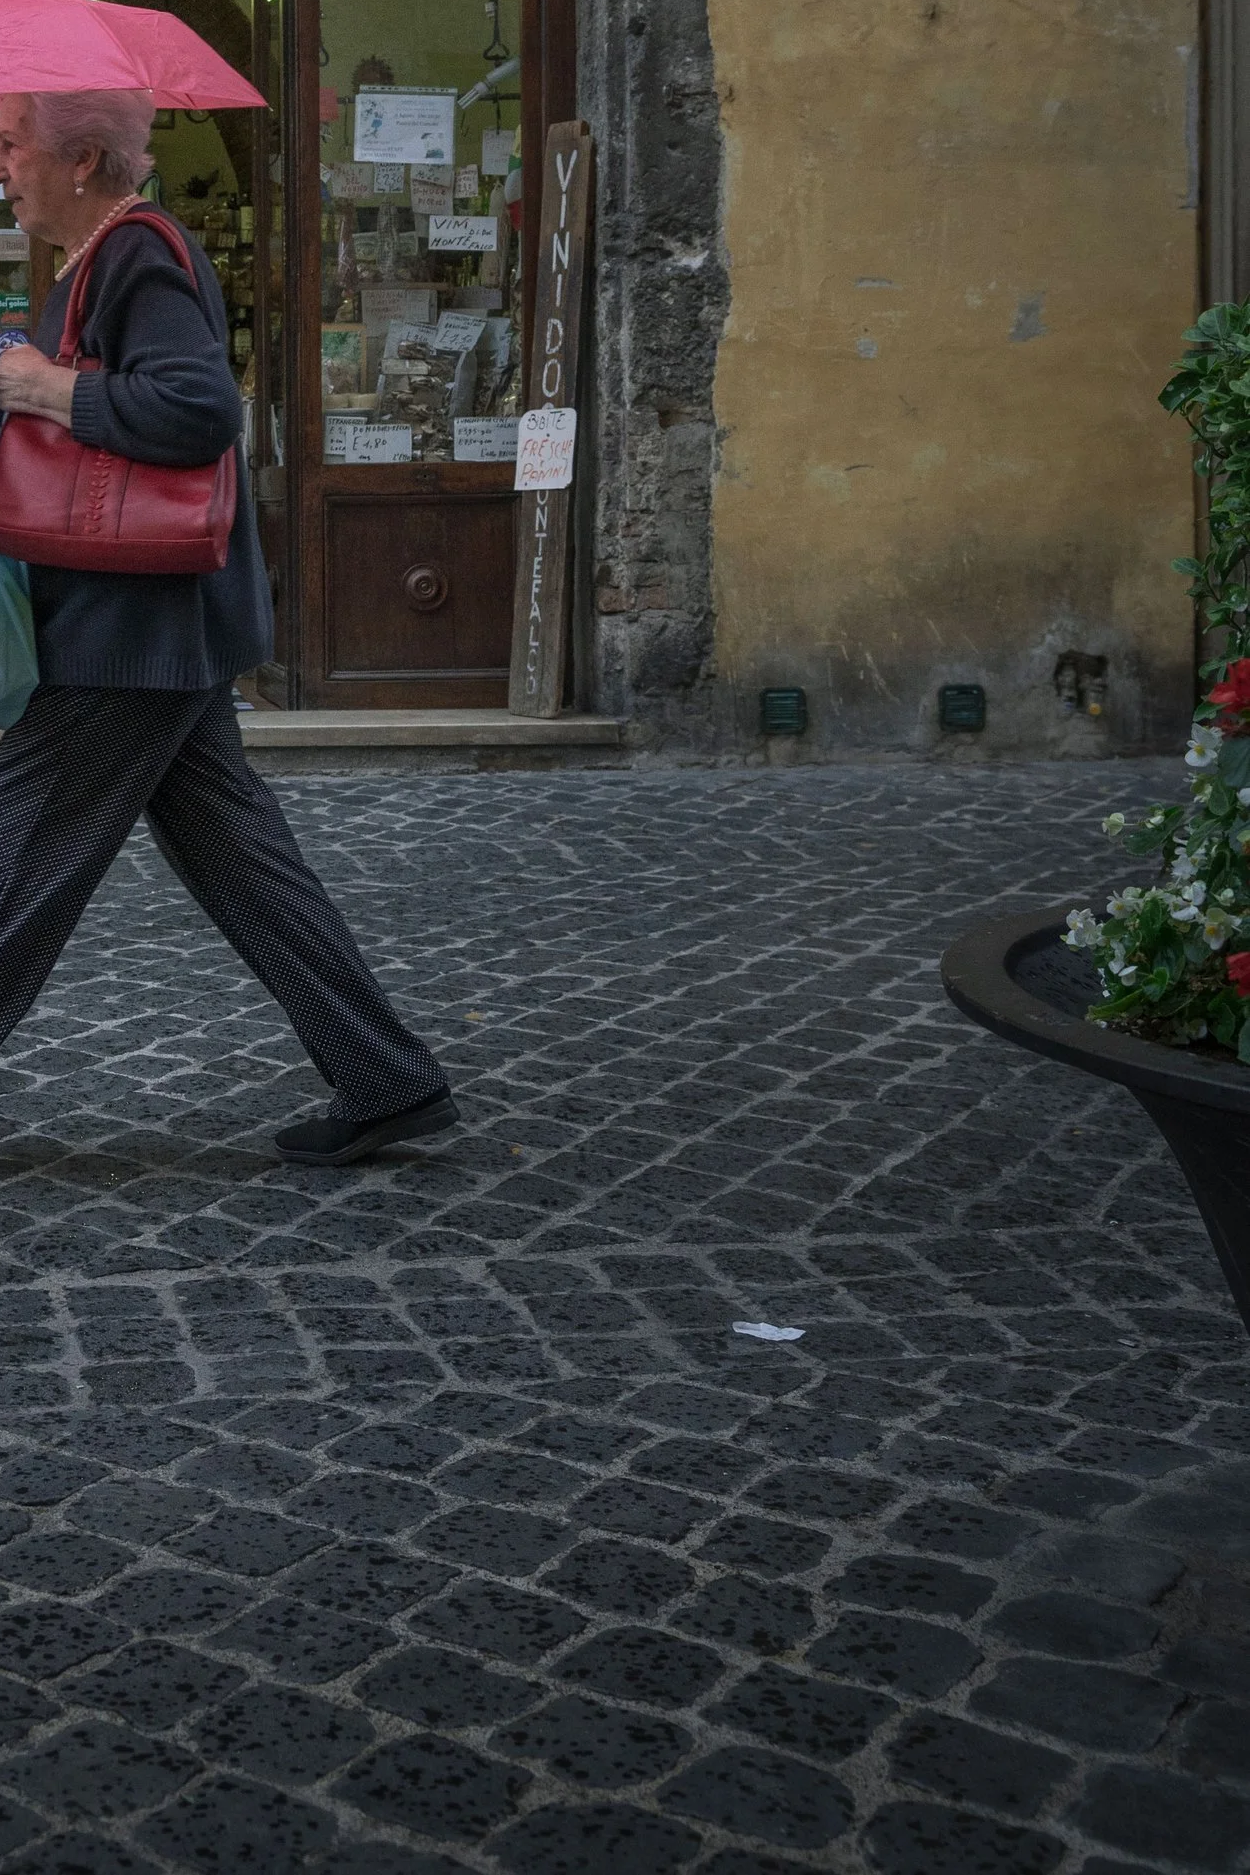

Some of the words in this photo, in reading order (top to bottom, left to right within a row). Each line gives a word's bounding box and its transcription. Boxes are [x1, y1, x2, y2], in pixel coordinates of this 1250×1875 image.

[551, 150, 578, 307] VINI
[527, 411, 566, 430] BIBITE
[526, 489, 550, 694] ONTEFALCO
